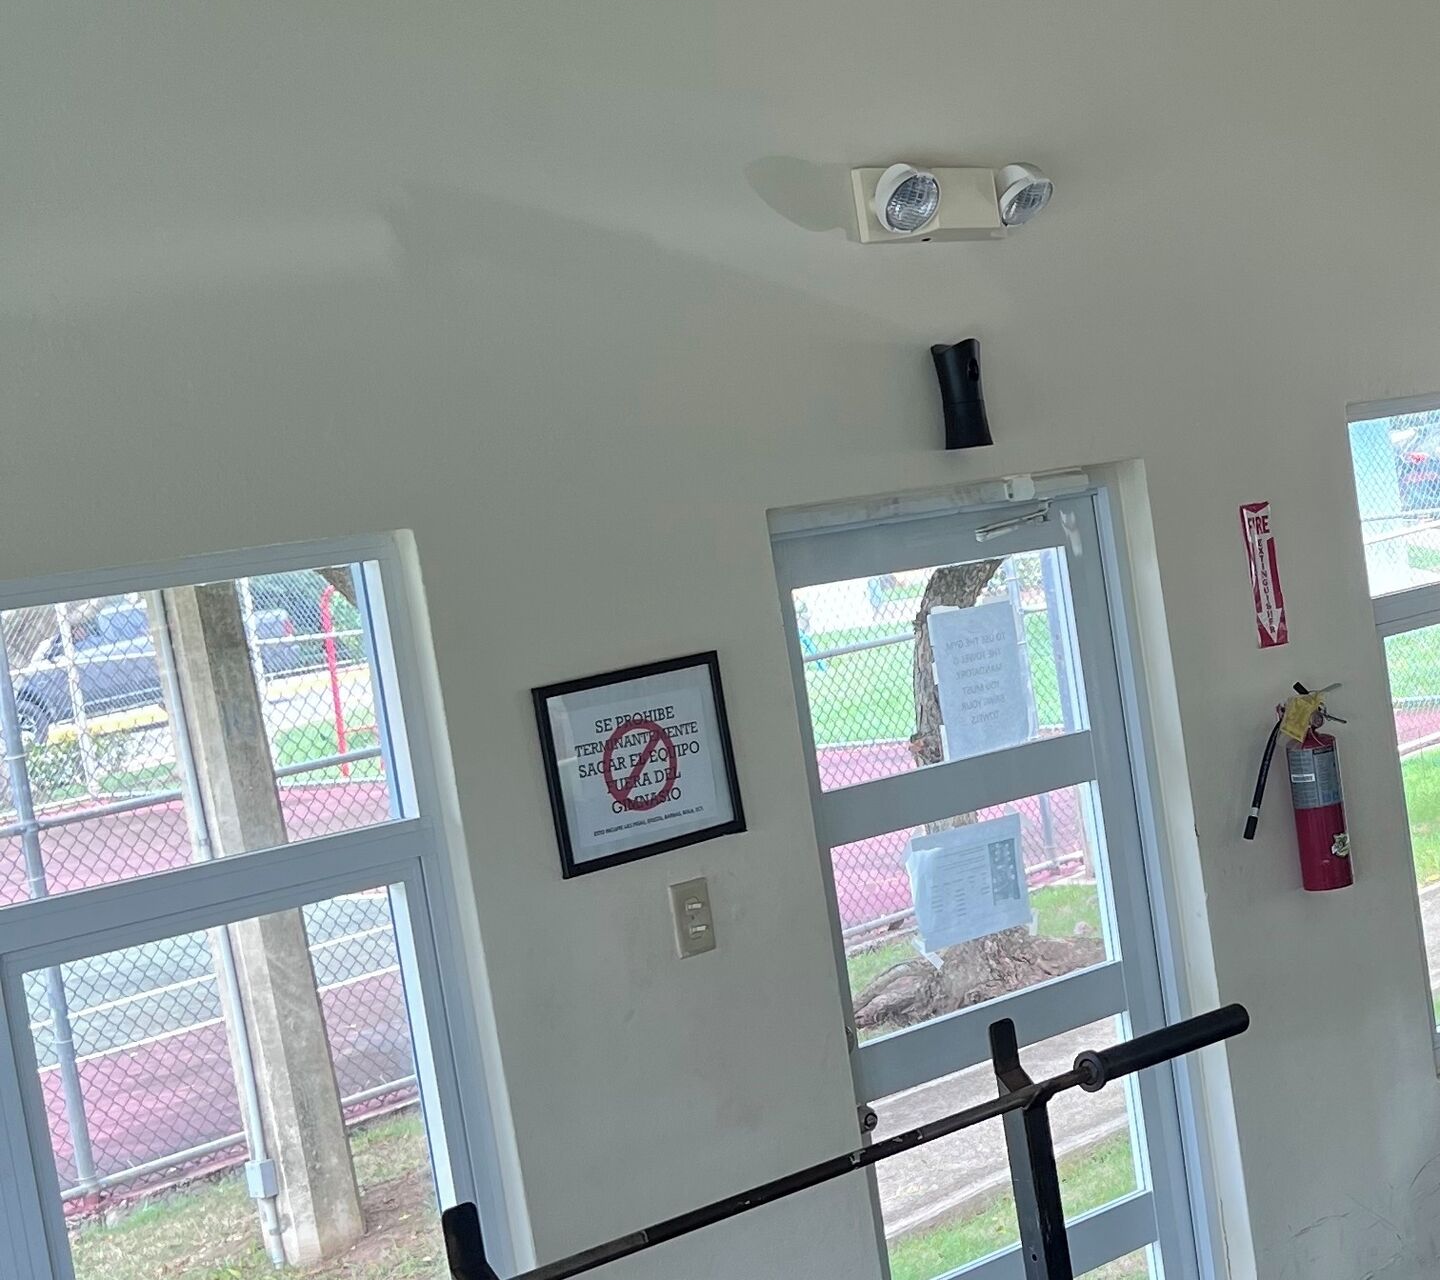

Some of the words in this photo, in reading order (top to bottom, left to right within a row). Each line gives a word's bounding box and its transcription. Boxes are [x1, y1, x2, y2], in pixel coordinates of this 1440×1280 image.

[1248, 515, 1270, 535] FIRE
[1257, 538, 1276, 634] EXTINGUISHER
[595, 717, 613, 734] SE
[615, 705, 675, 728] PROHIBE
[578, 755, 627, 779] SACAR
[629, 752, 645, 768] EL
[649, 741, 700, 764] EQUIPO
[607, 772, 654, 794] FUERA
[654, 767, 681, 786] DEL
[612, 787, 682, 814] GIMNASIO
